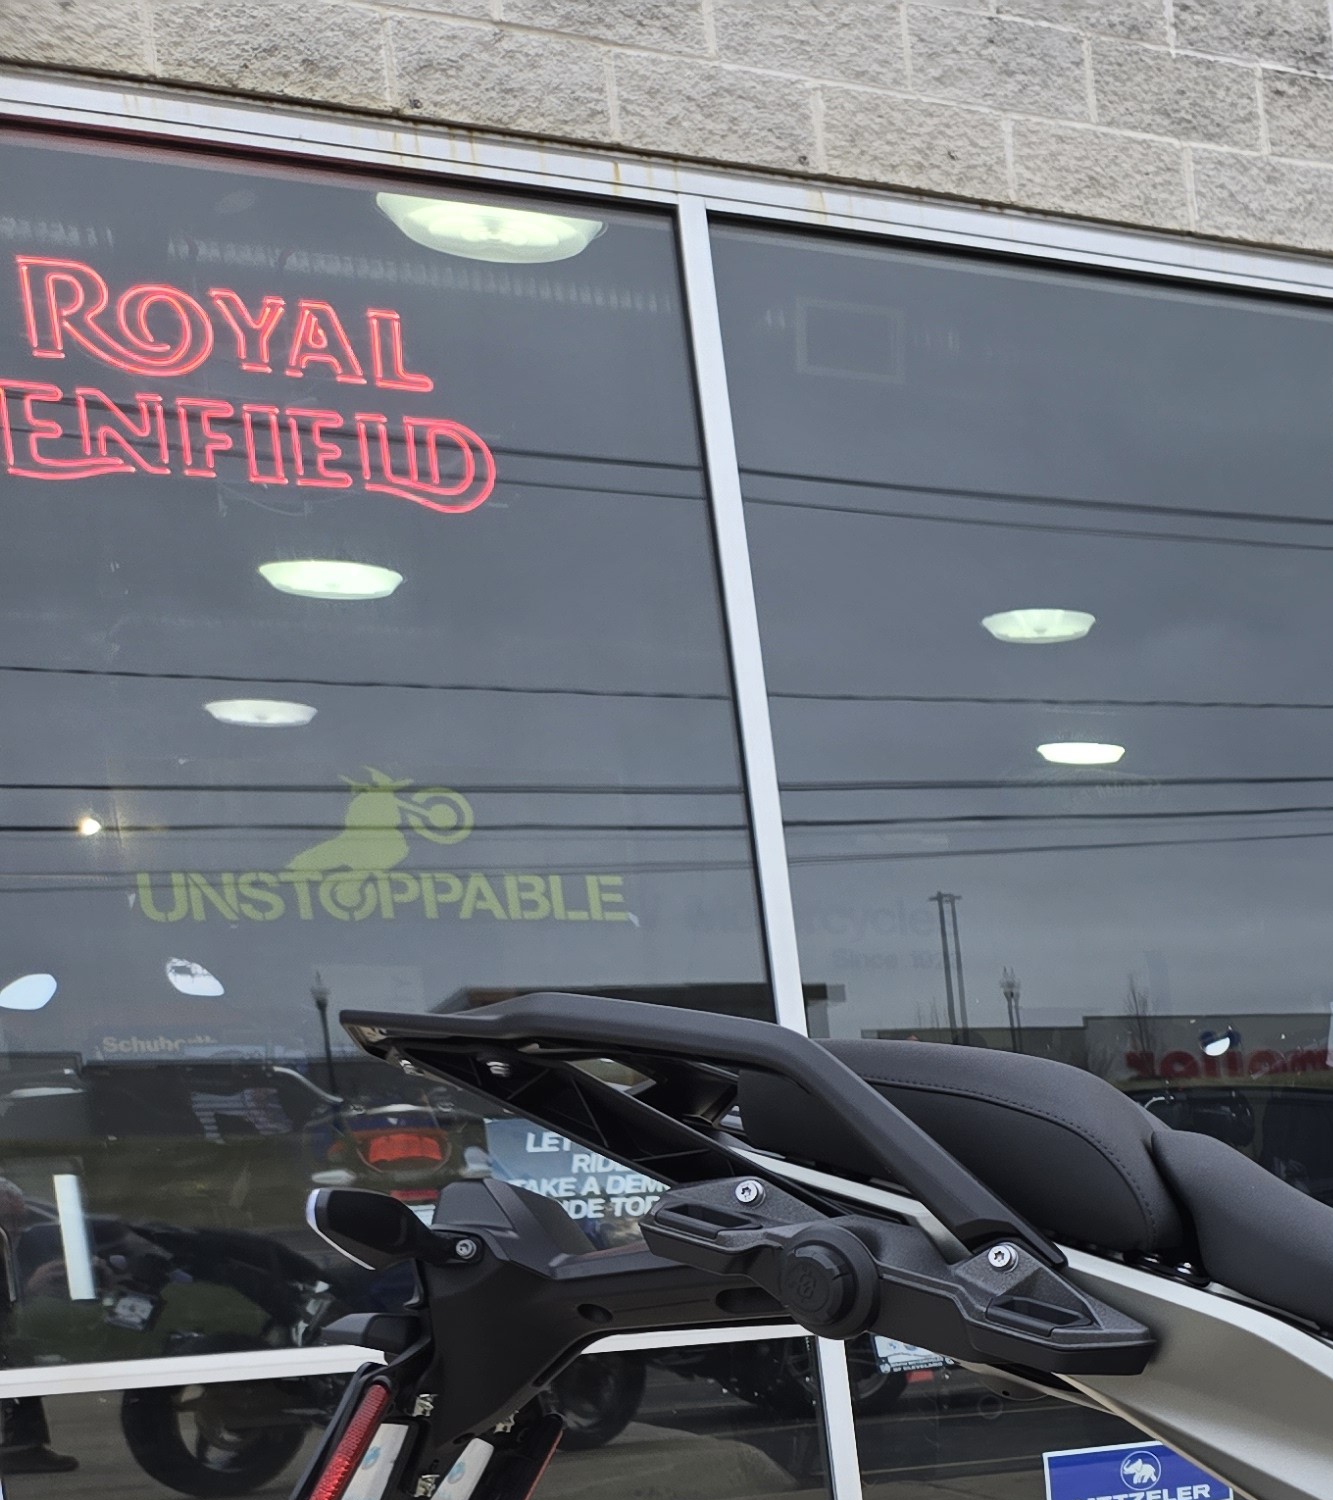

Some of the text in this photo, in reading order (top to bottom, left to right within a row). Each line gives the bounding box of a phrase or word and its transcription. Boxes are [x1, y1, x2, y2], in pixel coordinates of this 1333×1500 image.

[15, 255, 434, 393] ROYAL
[0, 378, 497, 514] ENFIELD
[136, 872, 629, 922] UNSTOPPABLE
[562, 1197, 606, 1220] IDE
[581, 1175, 602, 1196] A
[605, 1174, 671, 1195] DEM
